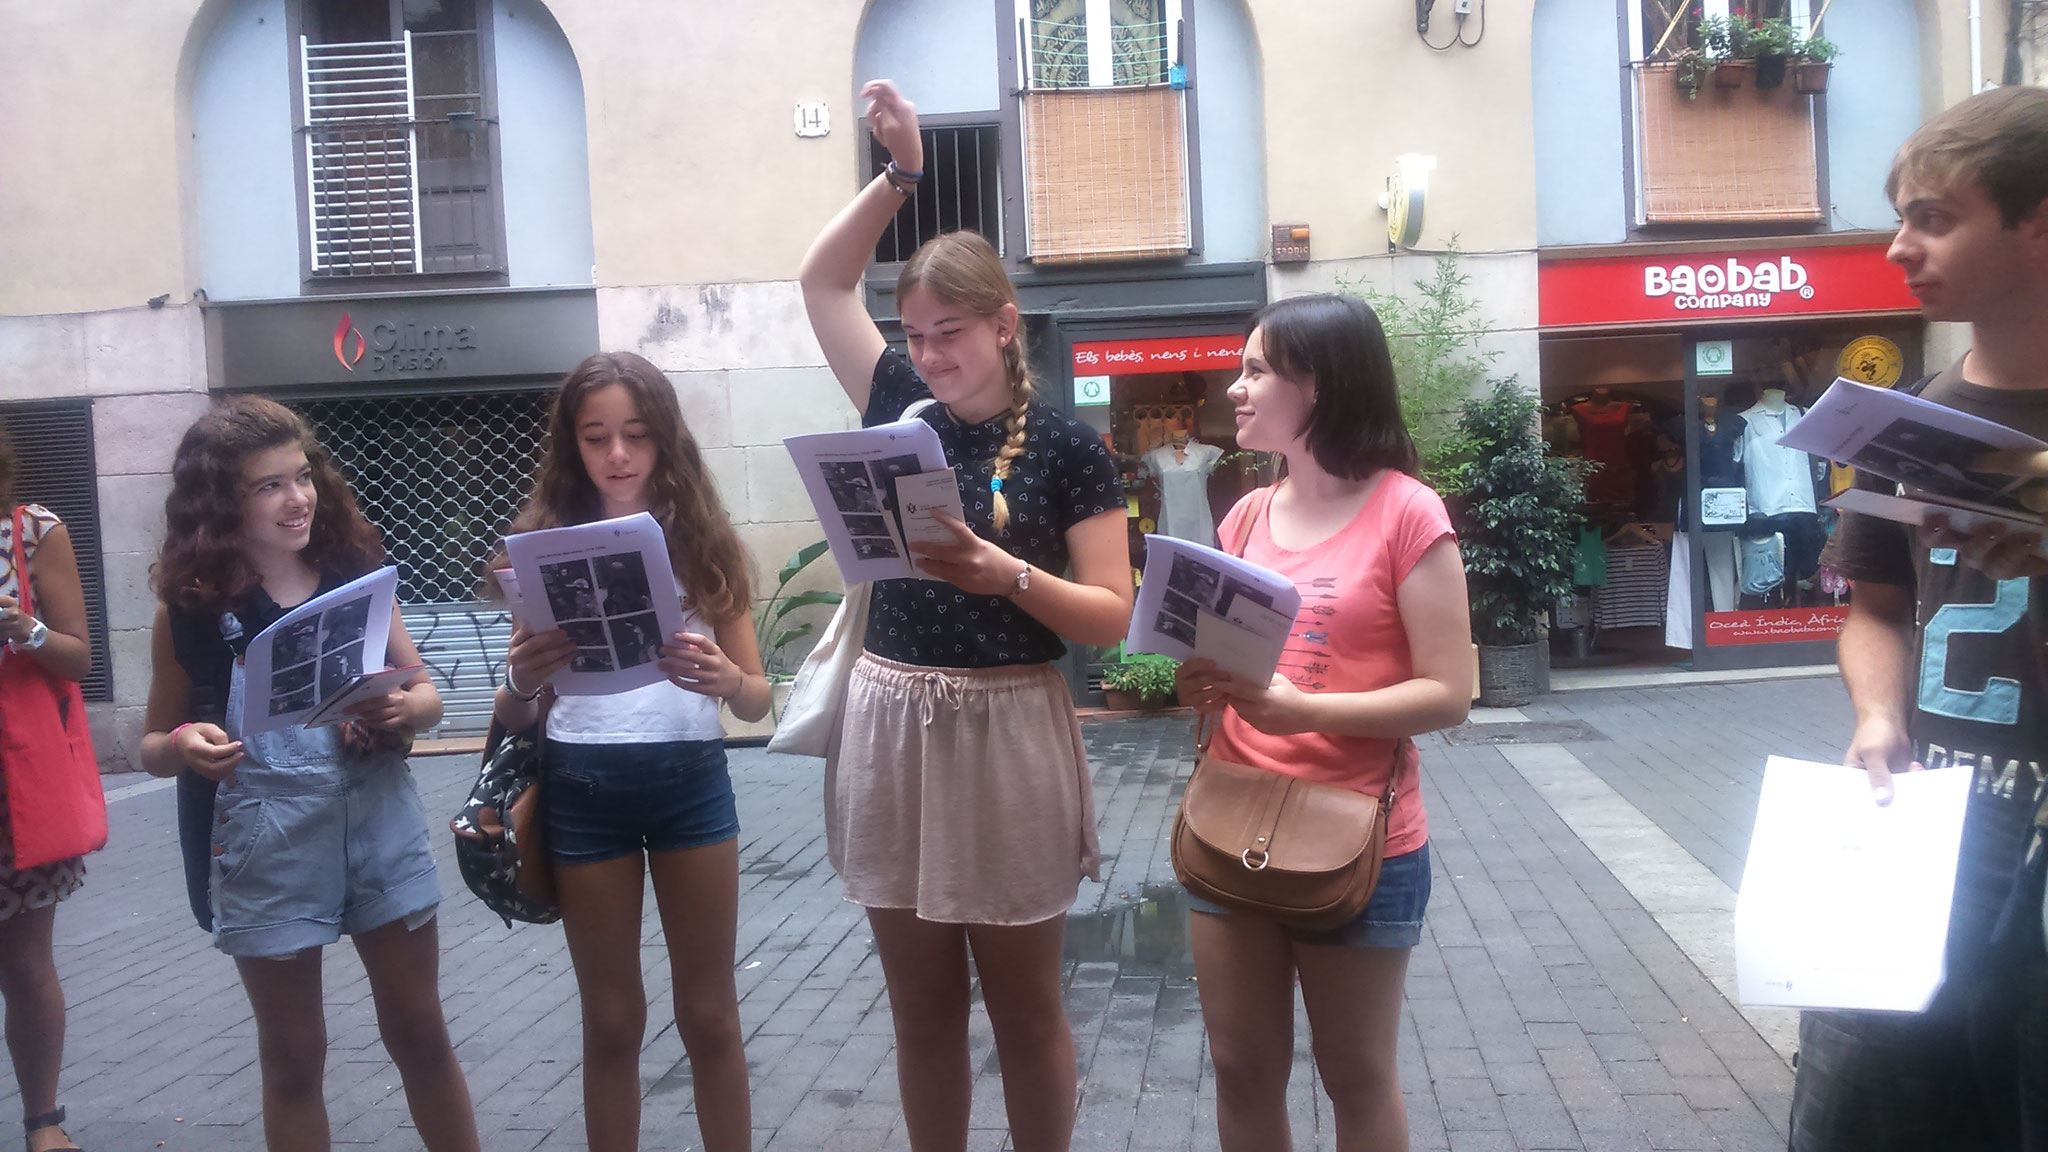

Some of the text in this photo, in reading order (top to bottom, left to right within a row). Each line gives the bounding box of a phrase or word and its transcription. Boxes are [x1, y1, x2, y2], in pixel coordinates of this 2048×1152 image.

[801, 108, 822, 128] 14
[1644, 256, 1808, 296] Baobab
[373, 317, 478, 354] Clima
[1075, 351, 1099, 364] Els
[1150, 349, 1187, 360] nens
[1194, 348, 1202, 358] i
